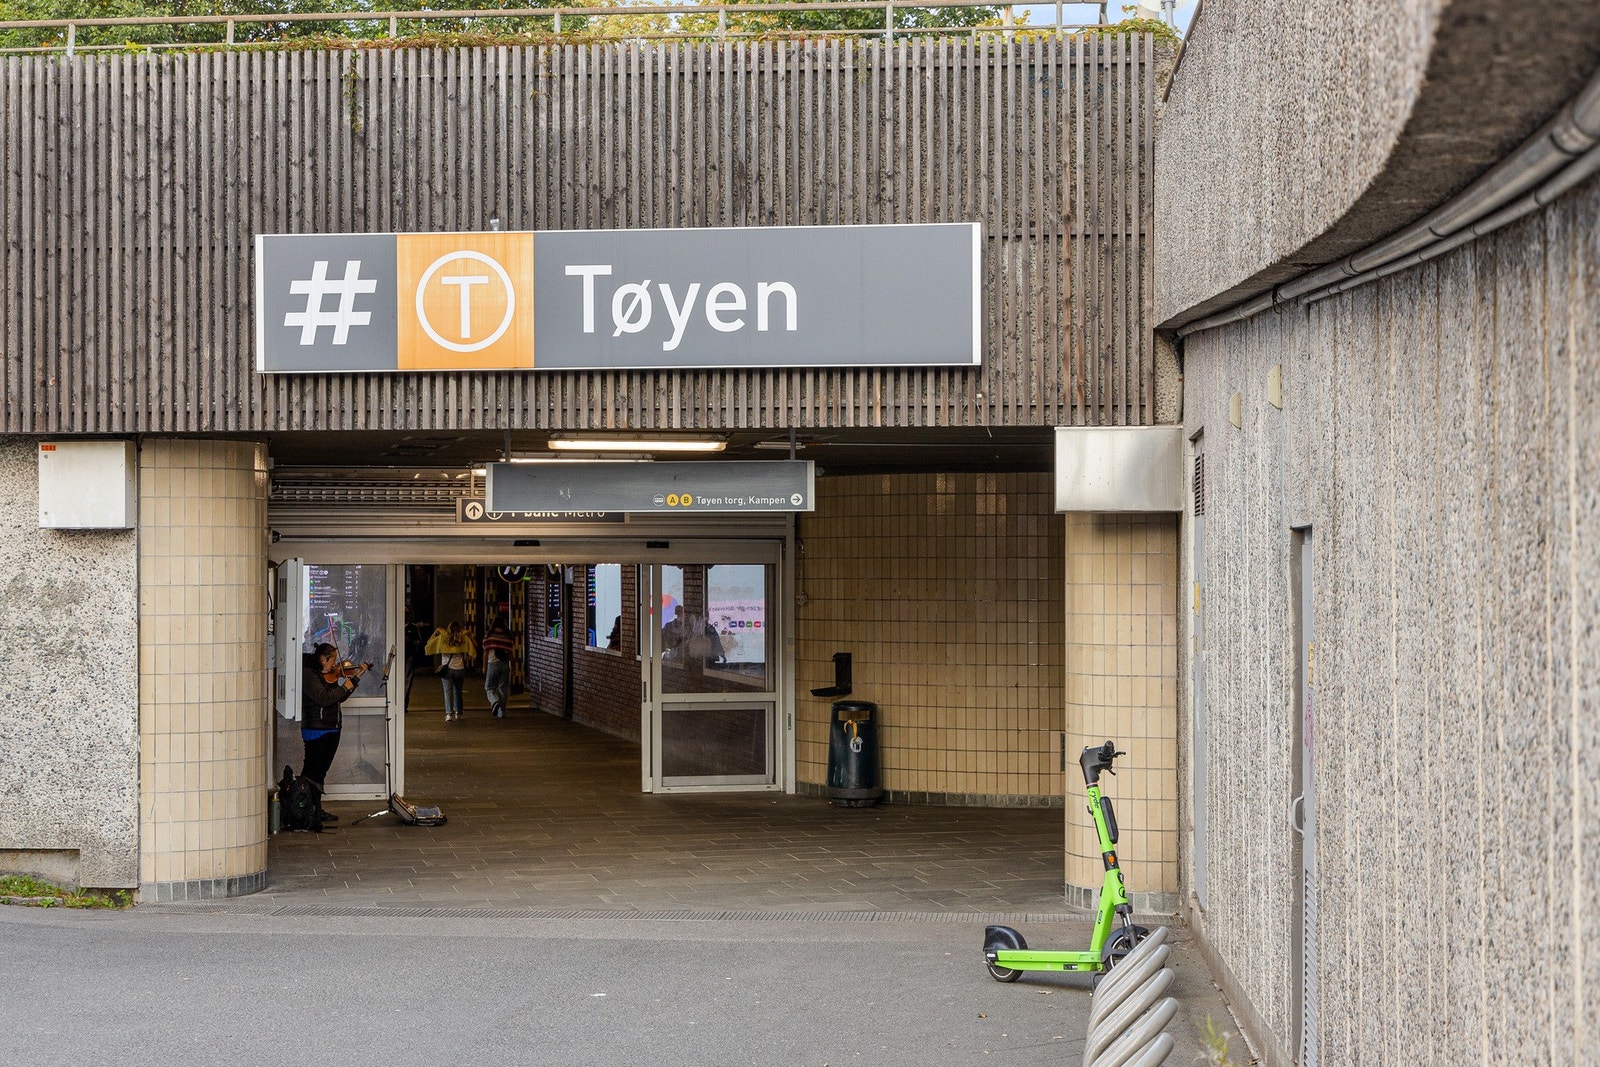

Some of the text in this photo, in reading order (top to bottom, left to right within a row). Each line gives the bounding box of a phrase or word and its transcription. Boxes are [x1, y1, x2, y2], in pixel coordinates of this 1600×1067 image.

[565, 264, 798, 352] Tøyen
[696, 496, 722, 506] Tøyen
[724, 496, 746, 506] torg,
[749, 495, 786, 506] Kampen
